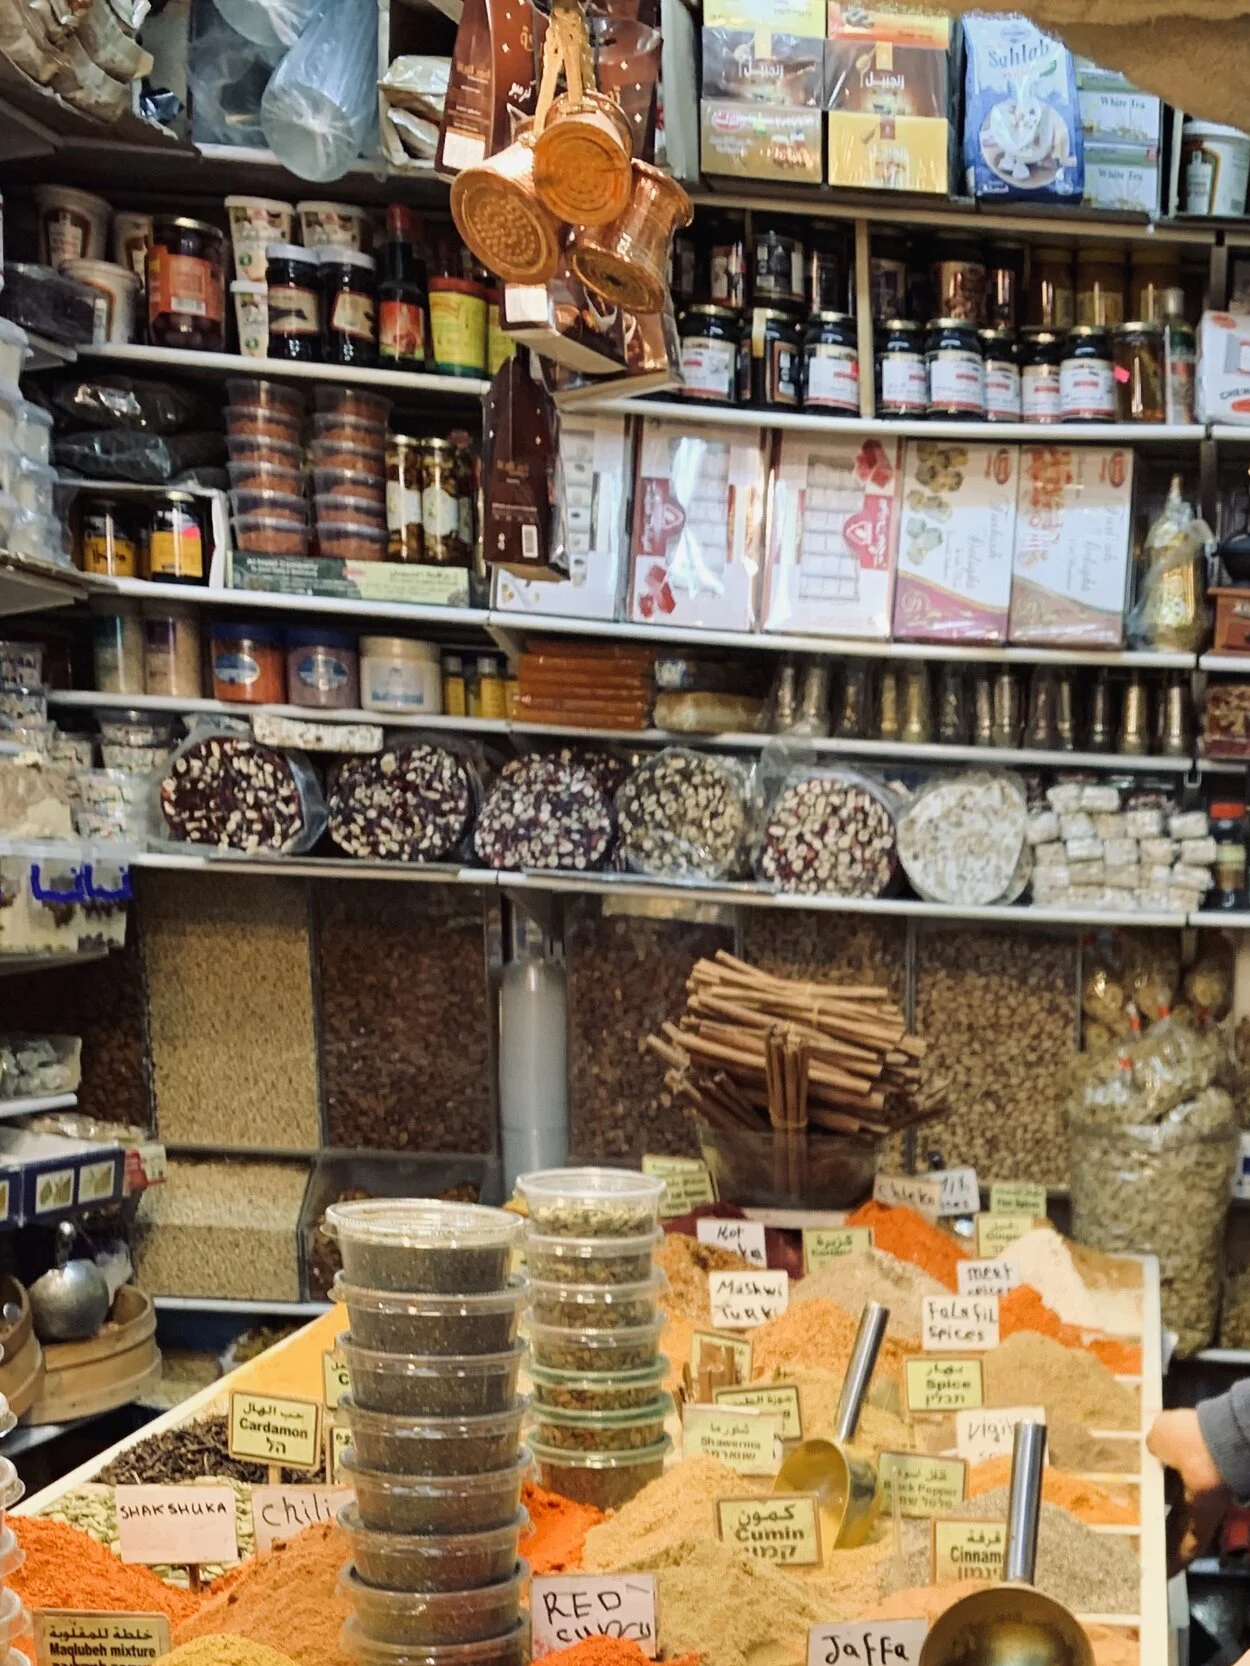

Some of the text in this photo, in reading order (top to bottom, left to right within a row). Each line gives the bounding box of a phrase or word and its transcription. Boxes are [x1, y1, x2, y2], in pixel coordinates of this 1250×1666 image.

[1101, 97, 1128, 107] White
[1100, 168, 1125, 179] White
[926, 1379, 971, 1391] Spice
[239, 1417, 308, 1440] Cardamon
[266, 1437, 286, 1454] הל
[120, 1503, 227, 1519] SHAKSHUKA
[739, 1504, 796, 1527] كمون
[735, 1527, 804, 1542] Cumin
[950, 1545, 1001, 1564] Cinnam
[543, 1592, 622, 1624] RED
[50, 1642, 156, 1664] Maqlubeh mixture
